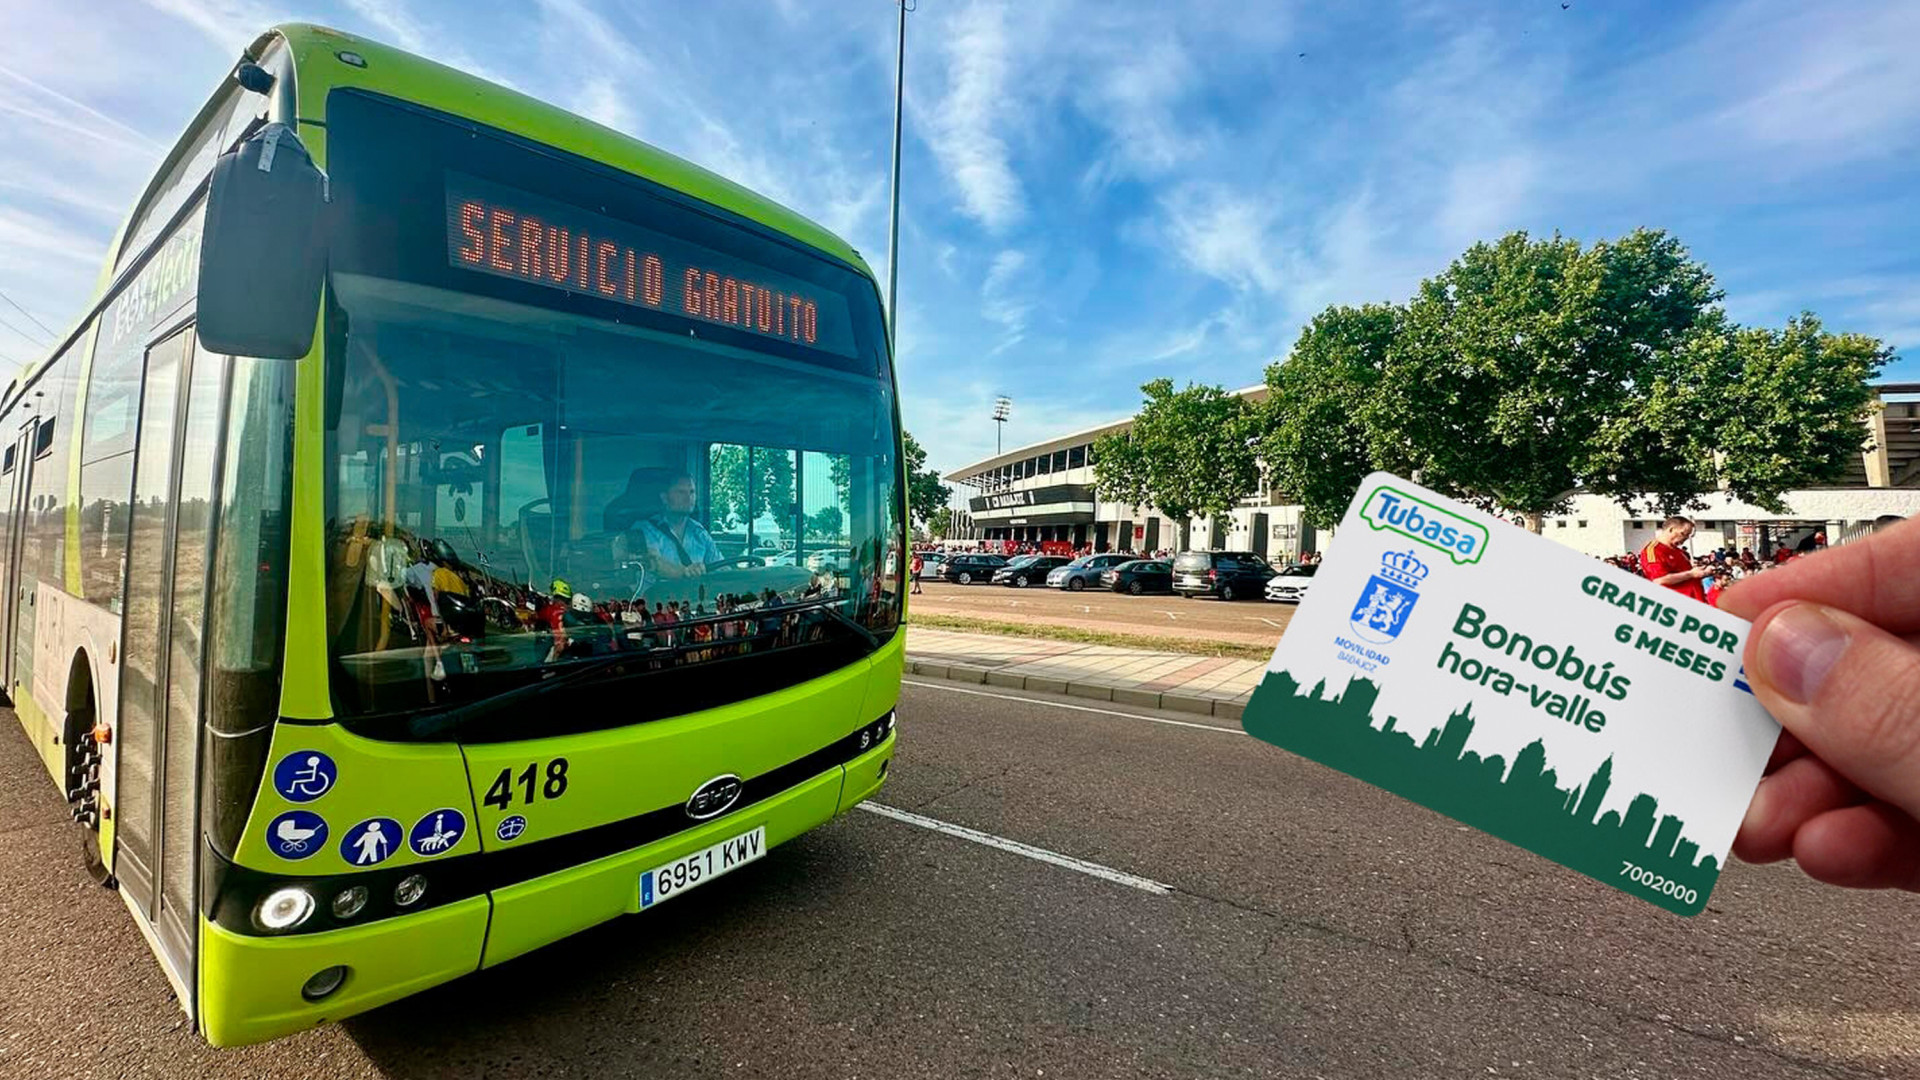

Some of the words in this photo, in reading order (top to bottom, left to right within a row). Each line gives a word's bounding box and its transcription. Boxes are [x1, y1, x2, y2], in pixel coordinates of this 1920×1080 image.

[460, 202, 662, 305] SERVICIO
[683, 266, 816, 343] GRATUITO
[1378, 491, 1477, 555] Tubasa
[1581, 575, 1679, 628] GRATIS
[1679, 614, 1739, 655] POR
[1333, 635, 1391, 666] MOVILIDAD
[1452, 602, 1632, 701] Bonobús
[1614, 623, 1634, 644] 6
[1634, 630, 1727, 682] MESES
[1437, 641, 1607, 734] hora-valle
[483, 757, 570, 811] 418
[694, 782, 738, 809] BYD
[658, 850, 715, 895] 6951
[723, 830, 760, 869] KWV
[1620, 860, 1698, 905] 7002000
